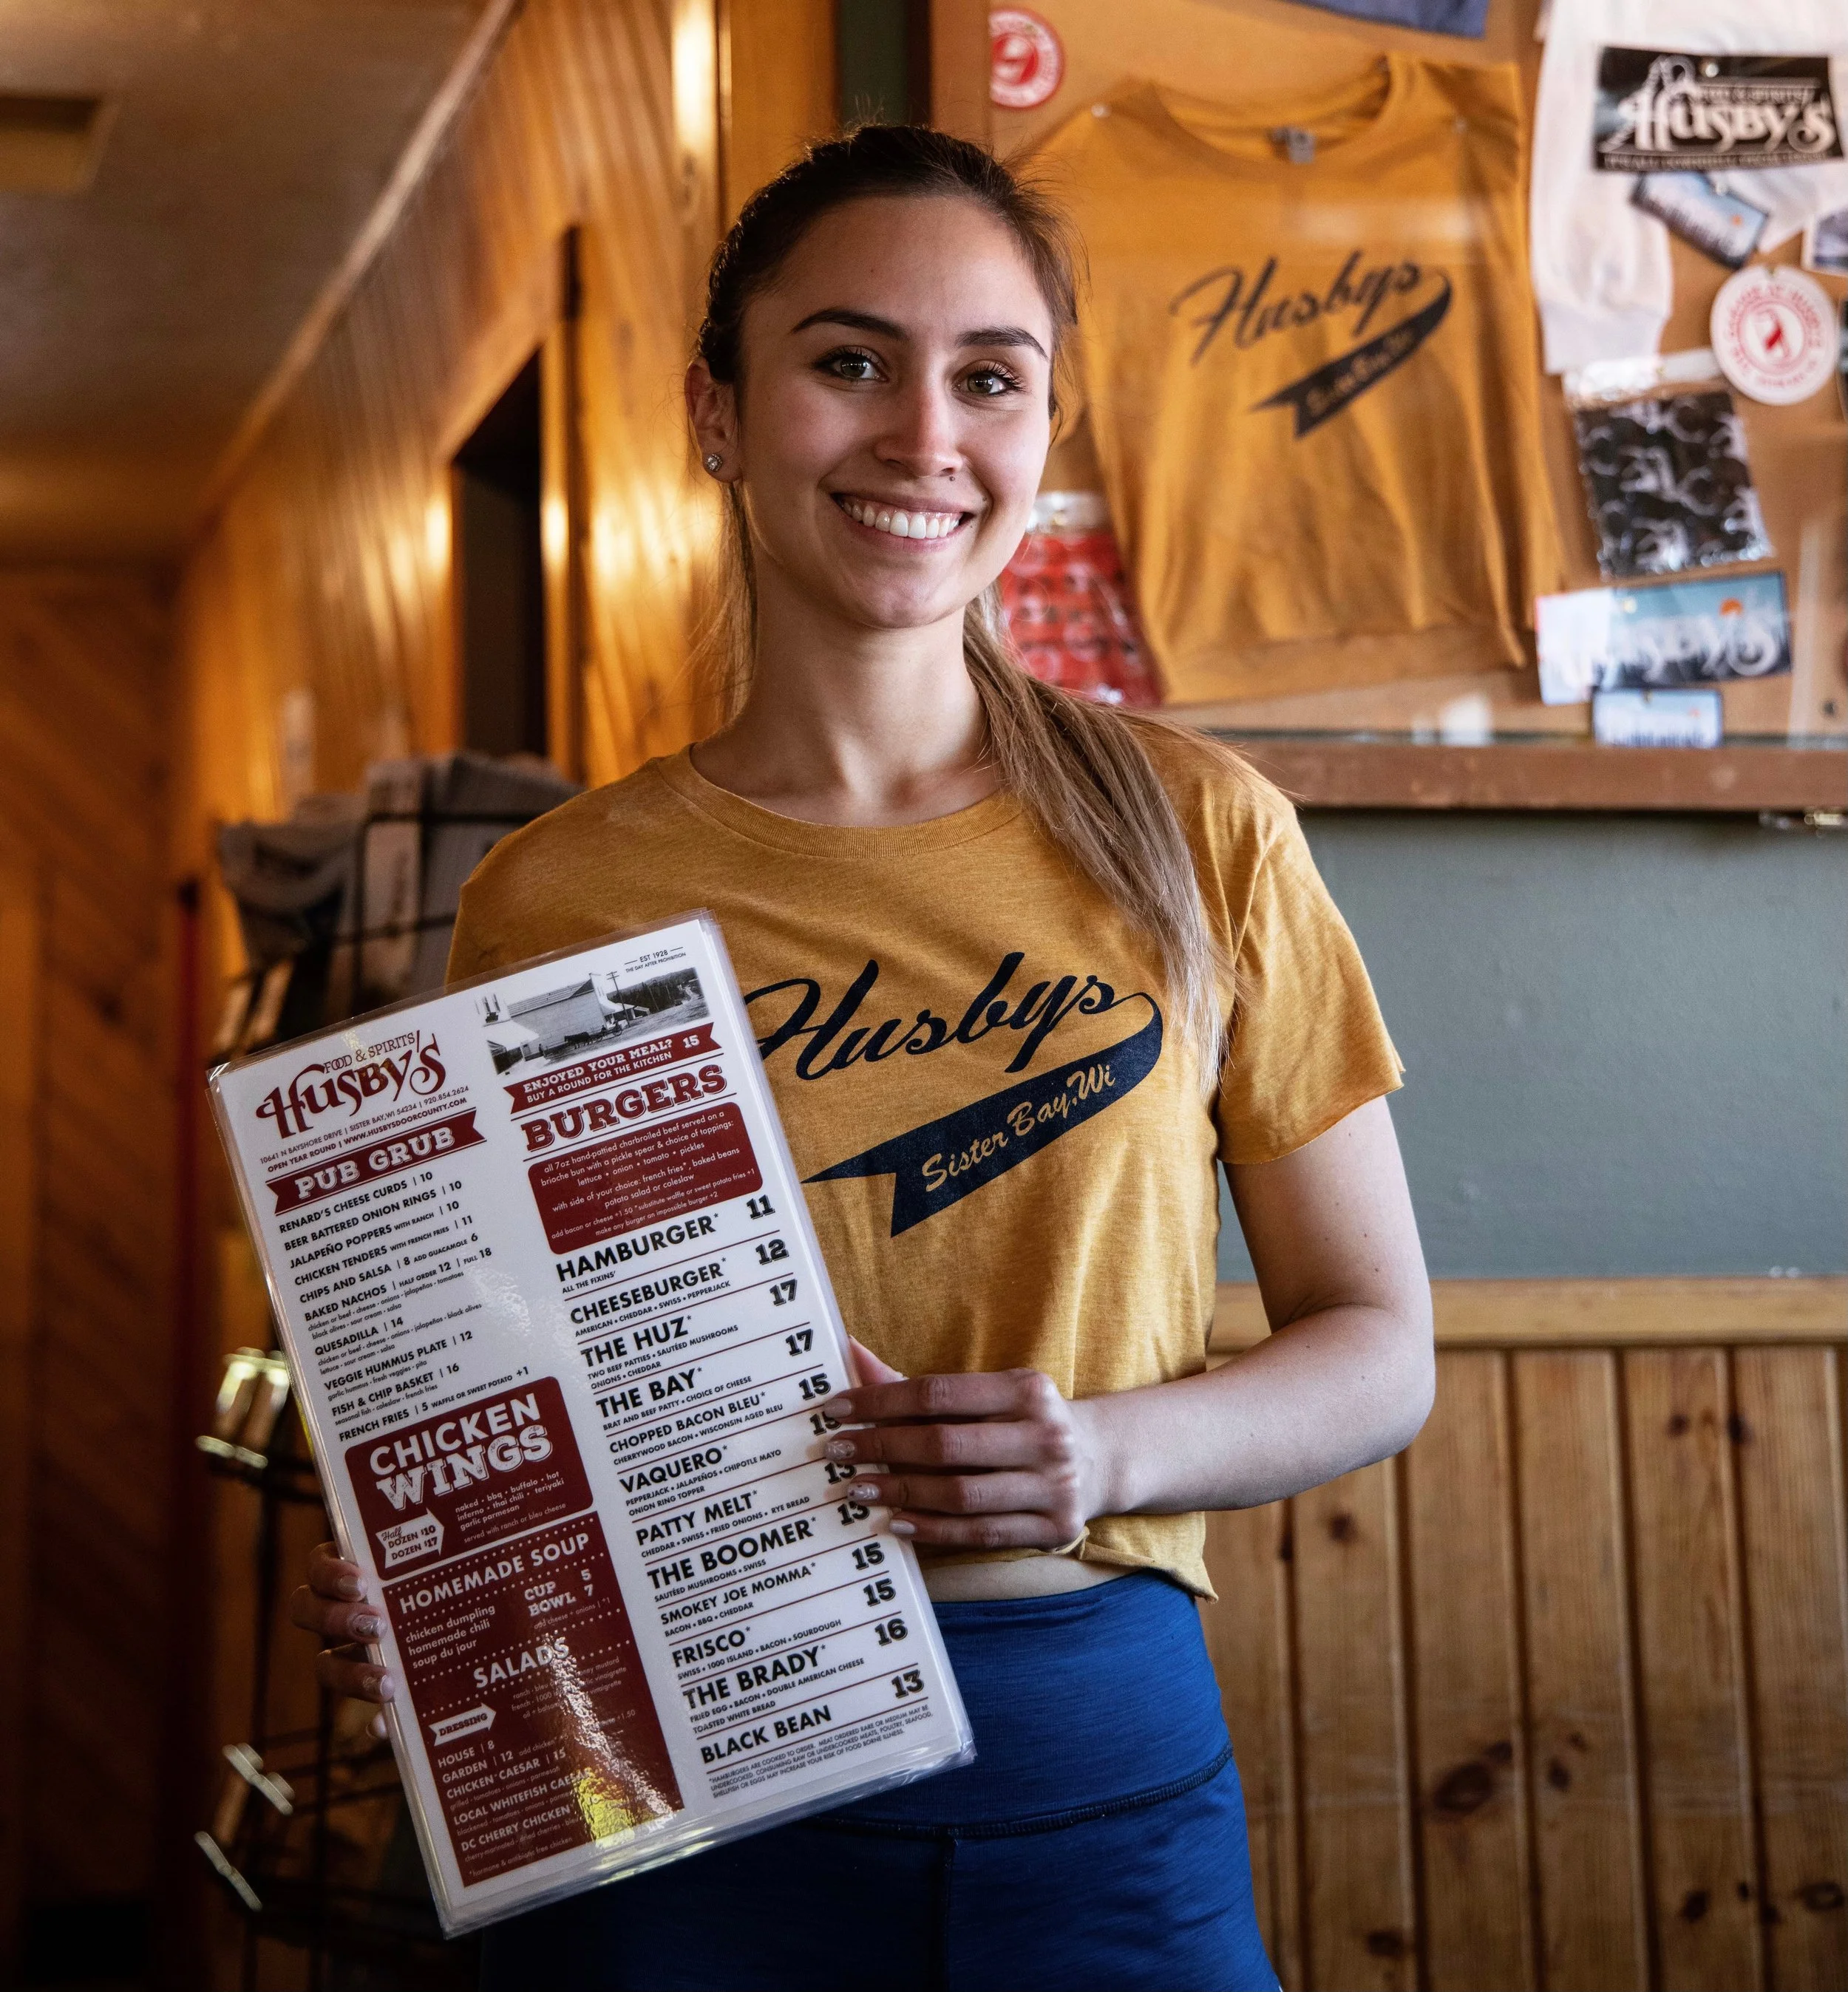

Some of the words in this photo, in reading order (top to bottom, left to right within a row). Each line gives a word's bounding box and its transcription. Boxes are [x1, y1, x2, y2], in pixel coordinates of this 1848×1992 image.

[1168, 248, 1421, 369] Husbys
[639, 953, 650, 962] EST
[652, 949, 668, 959] 1928
[657, 952, 686, 963] PROHIBITION
[741, 952, 1115, 1081] Husbys
[322, 1054, 353, 1074] FOOD
[355, 1049, 367, 1062] &
[367, 1031, 415, 1058] SPIRITS
[523, 1066, 585, 1093] ENJOYED
[587, 1053, 626, 1072] YOUR
[628, 1039, 673, 1059] MEAL?
[682, 1034, 700, 1048] 15
[526, 1090, 545, 1103] BUY
[548, 1087, 556, 1096] A
[557, 1076, 591, 1093] ROUND
[593, 1070, 613, 1081] FOR
[613, 1063, 631, 1075] THE
[632, 1050, 672, 1069] KITCHEN
[259, 1152, 279, 1164] 10641
[280, 1149, 288, 1157] N
[288, 1136, 322, 1154] BAYSHORE
[322, 1129, 343, 1141] DRIVE
[349, 1119, 371, 1132] SISTER
[396, 1103, 417, 1115] 54234
[423, 1085, 469, 1105] 920.854.2624
[520, 1064, 727, 1152] BURGERS
[267, 1160, 288, 1172] OPEN
[288, 1153, 308, 1164] YEAR
[309, 1143, 336, 1158] ROUND
[343, 1097, 467, 1144] WWW.HUSBYSDOORCOUNTY.COM
[294, 1160, 360, 1199] PUB
[368, 1126, 455, 1171] GRUB
[577, 1174, 602, 1186] lettuce
[612, 1163, 633, 1175] onion
[642, 1152, 670, 1165] tomato
[679, 1141, 705, 1156] pickles
[921, 1130, 1010, 1192] Sister
[279, 1207, 331, 1234] RENARD'S
[333, 1192, 370, 1213] CHEESE
[373, 1180, 407, 1199] CURDS
[419, 1171, 432, 1182] 10
[284, 1235, 309, 1251] BEER
[310, 1217, 359, 1241] BATTERED
[361, 1201, 400, 1222] ONION
[401, 1189, 437, 1208] RINGS
[449, 1180, 462, 1192] 10
[746, 1194, 775, 1220] 11
[290, 1242, 344, 1268] JALAPEÑO
[345, 1223, 393, 1248] POPPERS
[393, 1220, 411, 1231] WITH
[411, 1211, 435, 1224] RANCH
[446, 1200, 459, 1211] 10
[294, 1262, 340, 1285] CHICKEN
[341, 1245, 387, 1268] TENDERS
[389, 1241, 407, 1251] WITH
[407, 1231, 432, 1245] FRENCH
[432, 1226, 449, 1237] FRIES
[461, 1214, 472, 1226] 11
[755, 1238, 789, 1265] 12
[562, 1285, 575, 1294] ALL
[574, 1279, 589, 1289] THE
[575, 1319, 614, 1337] AMERICAN
[619, 1305, 653, 1322] CHEDDAR
[658, 1296, 682, 1309] SWISS
[687, 1279, 730, 1299] PEPPERJACK
[314, 1326, 379, 1356] QUESADILLA
[390, 1316, 404, 1328] 14
[580, 1336, 628, 1367] THE
[769, 1278, 798, 1307] 17
[323, 1369, 363, 1390] VEGGIE
[364, 1350, 415, 1376] HUMMUS
[416, 1339, 447, 1357] PLATE
[459, 1330, 473, 1342] 12
[327, 1390, 344, 1402] garlic
[344, 1381, 369, 1394] hummus
[372, 1373, 387, 1384] fresh
[387, 1365, 411, 1378] veggies
[415, 1360, 427, 1370] pita
[595, 1387, 643, 1418] THE
[785, 1328, 813, 1357] 17
[370, 1392, 540, 1475] CHICKEN
[609, 1424, 672, 1453] CHOPPED
[675, 1405, 725, 1431] BACON
[798, 1372, 831, 1401] 15
[376, 1424, 553, 1511] WINGS
[455, 1498, 479, 1513] naked
[486, 1492, 503, 1501] bbq
[509, 1478, 538, 1493] buffalo
[546, 1470, 560, 1481] hot
[381, 1526, 402, 1541] Half
[387, 1531, 418, 1549] DOZEN
[391, 1543, 422, 1560] DOZEN
[399, 1554, 525, 1614] HOMEMADE
[530, 1532, 589, 1566] SOUP
[524, 1580, 556, 1600] CUP
[580, 1568, 591, 1581] 5
[863, 1577, 896, 1607] 15
[405, 1624, 444, 1643] chicken
[446, 1605, 495, 1628] dumpling
[528, 1591, 577, 1617] BOWL
[583, 1583, 593, 1597] 7
[407, 1628, 466, 1656] homemade
[469, 1617, 490, 1634] chili
[412, 1654, 438, 1669] soup
[440, 1648, 454, 1659] du
[455, 1639, 477, 1655] jour
[473, 1636, 573, 1688] SALADS
[682, 1676, 731, 1710] THE
[874, 1618, 908, 1646] 16
[438, 1712, 488, 1736] DRESSING
[700, 1725, 770, 1764] BLACK
[773, 1704, 832, 1738] BEAN
[891, 1668, 925, 1699] 13
[437, 1746, 475, 1768] HOUSE
[487, 1739, 495, 1750] 8
[441, 1759, 488, 1784] GARDEN
[500, 1750, 514, 1762] 12
[712, 1784, 740, 1798] SHELLFISH
[740, 1781, 750, 1789] OR
[749, 1775, 766, 1786] EGGS
[766, 1770, 778, 1780] MAY
[779, 1761, 806, 1775] INCREASE
[806, 1755, 823, 1765] YOUR
[823, 1750, 836, 1760] RISK
[835, 1747, 844, 1755] OF
[844, 1742, 862, 1753] FOOD
[862, 1735, 882, 1747] BORNE
[882, 1727, 905, 1739] ILLNESS.
[453, 1806, 489, 1825] LOCAL
[489, 1784, 548, 1812] WHITEFISH
